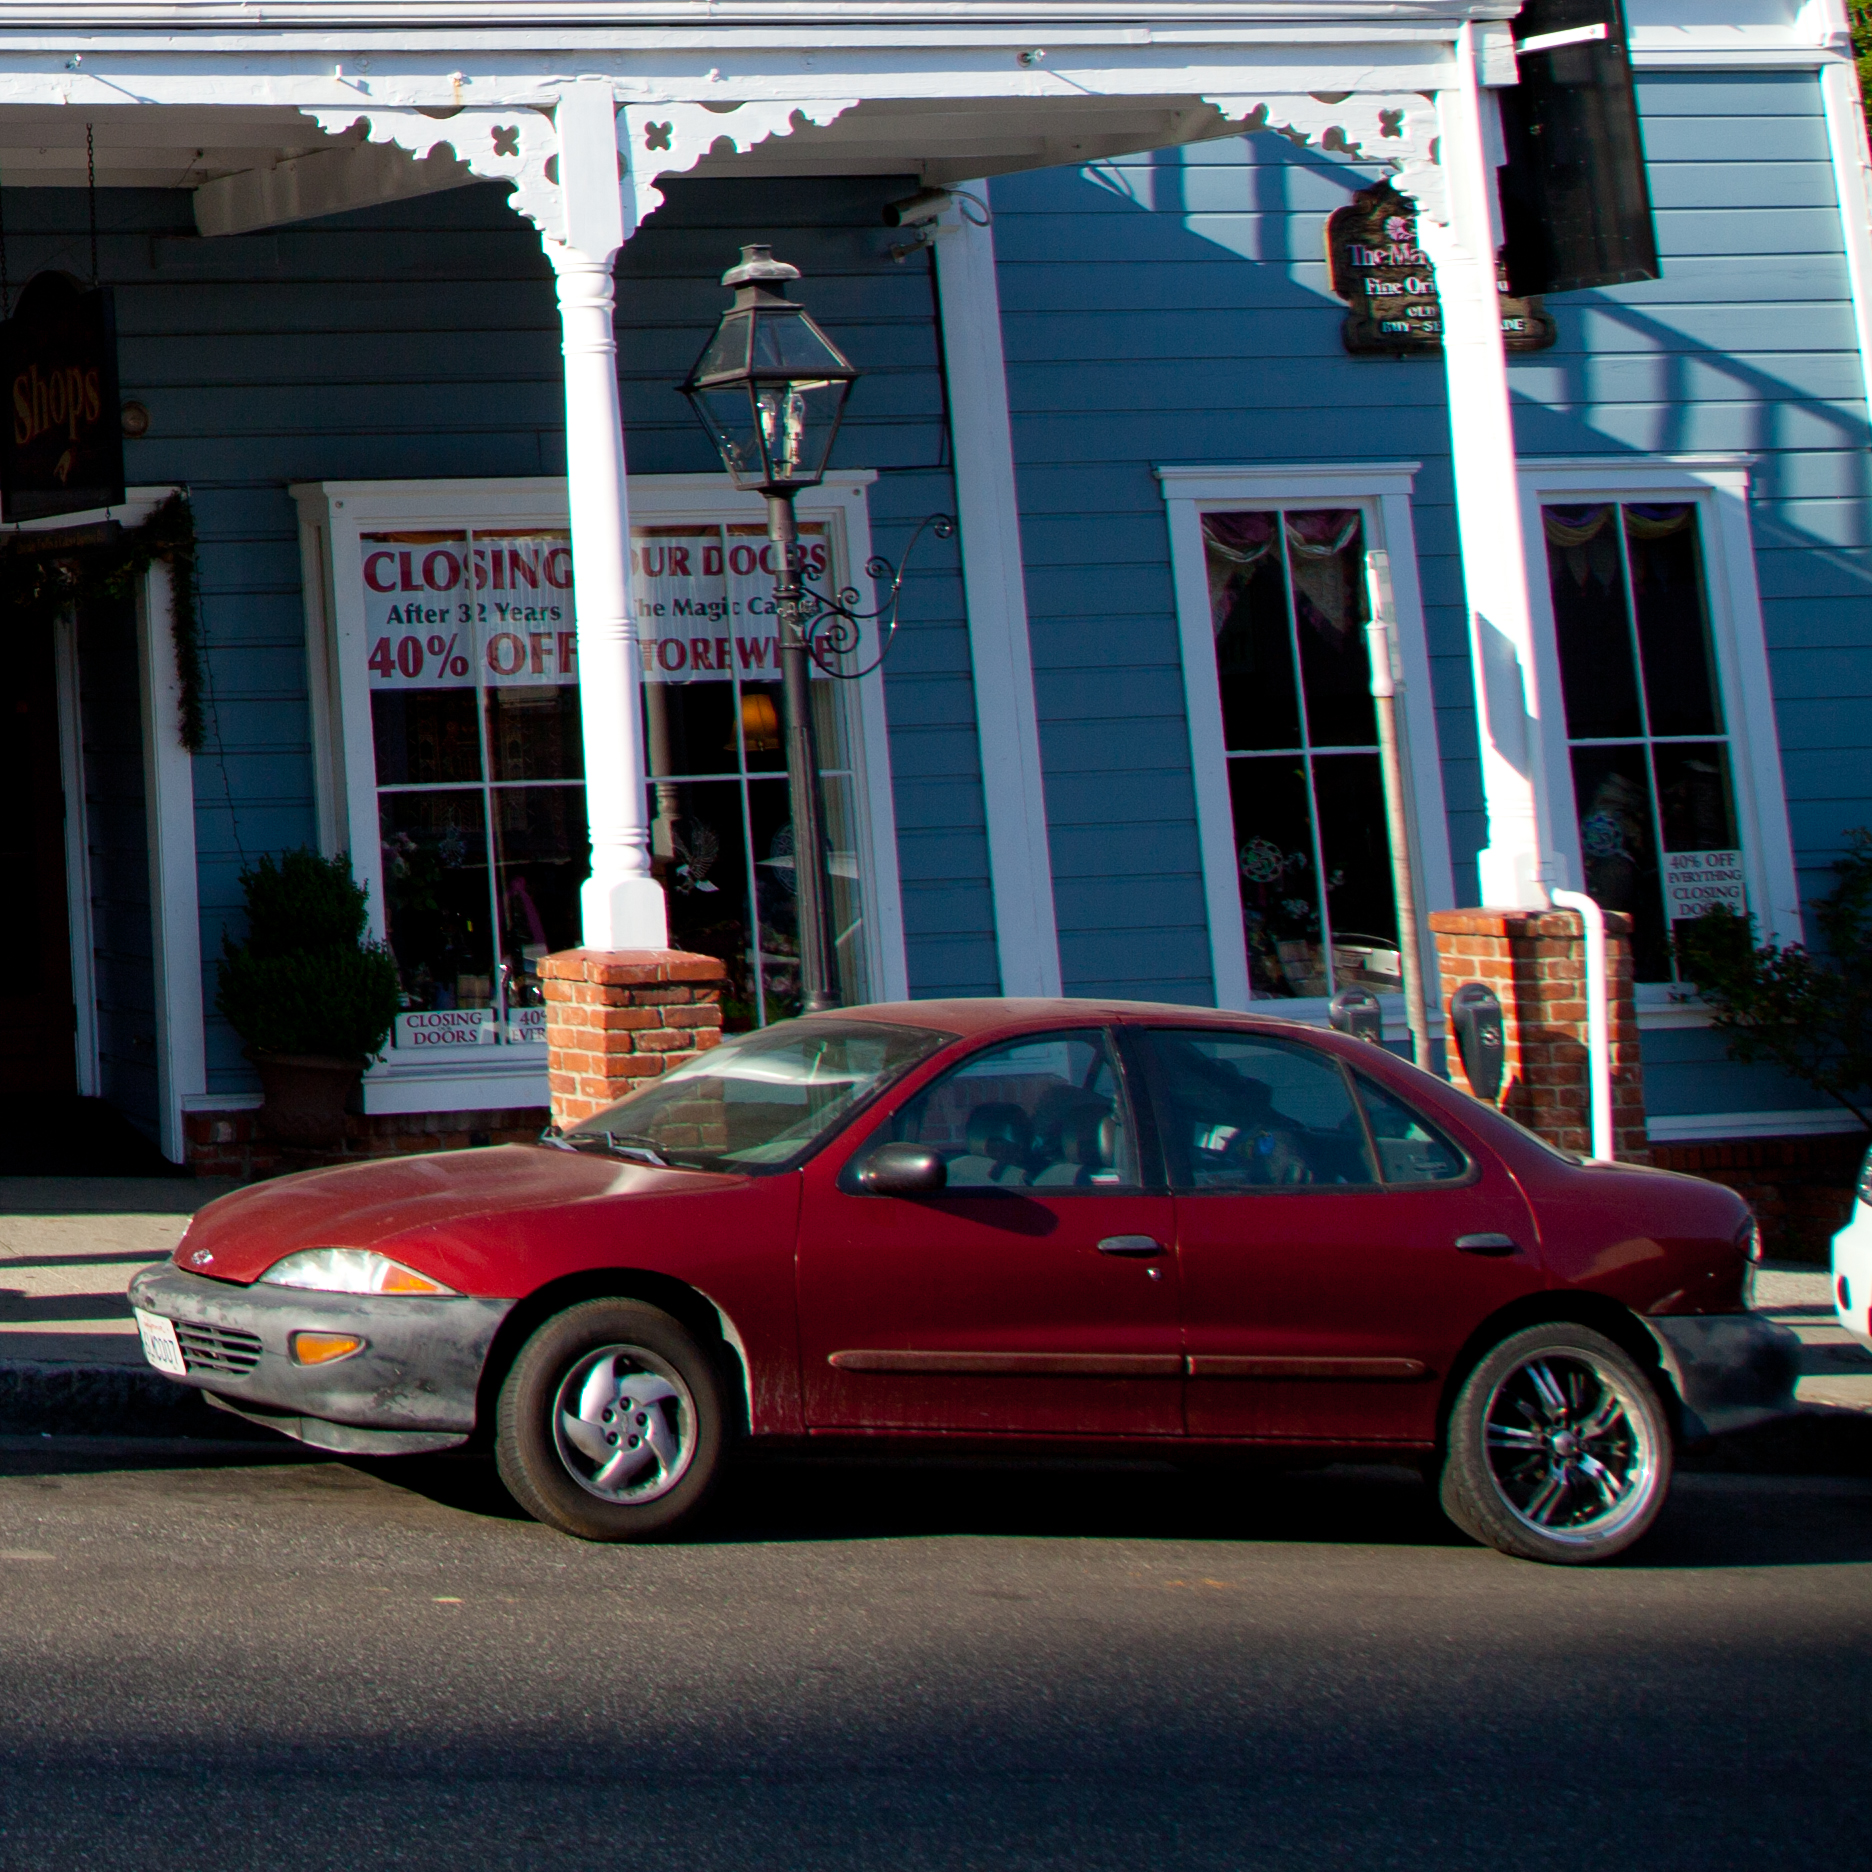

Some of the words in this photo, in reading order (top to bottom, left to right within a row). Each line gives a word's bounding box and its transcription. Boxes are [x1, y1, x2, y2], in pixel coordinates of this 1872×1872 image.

[1347, 243, 1389, 266] The
[1364, 277, 1403, 295] Fine
[13, 362, 101, 445] Shops
[363, 548, 573, 594] CLOSING
[386, 602, 450, 624] After
[458, 602, 487, 623] 32
[494, 602, 562, 622] Years
[672, 595, 741, 622] Magic
[368, 633, 470, 678] 40%
[486, 631, 578, 675] OFF
[1670, 854, 1701, 869] 40%
[1705, 852, 1735, 867] OFF
[1667, 869, 1742, 883] EVERYTHING
[1673, 886, 1739, 900] CLOSING
[407, 1011, 482, 1028] CLOSING
[414, 1029, 477, 1045] DOORS
